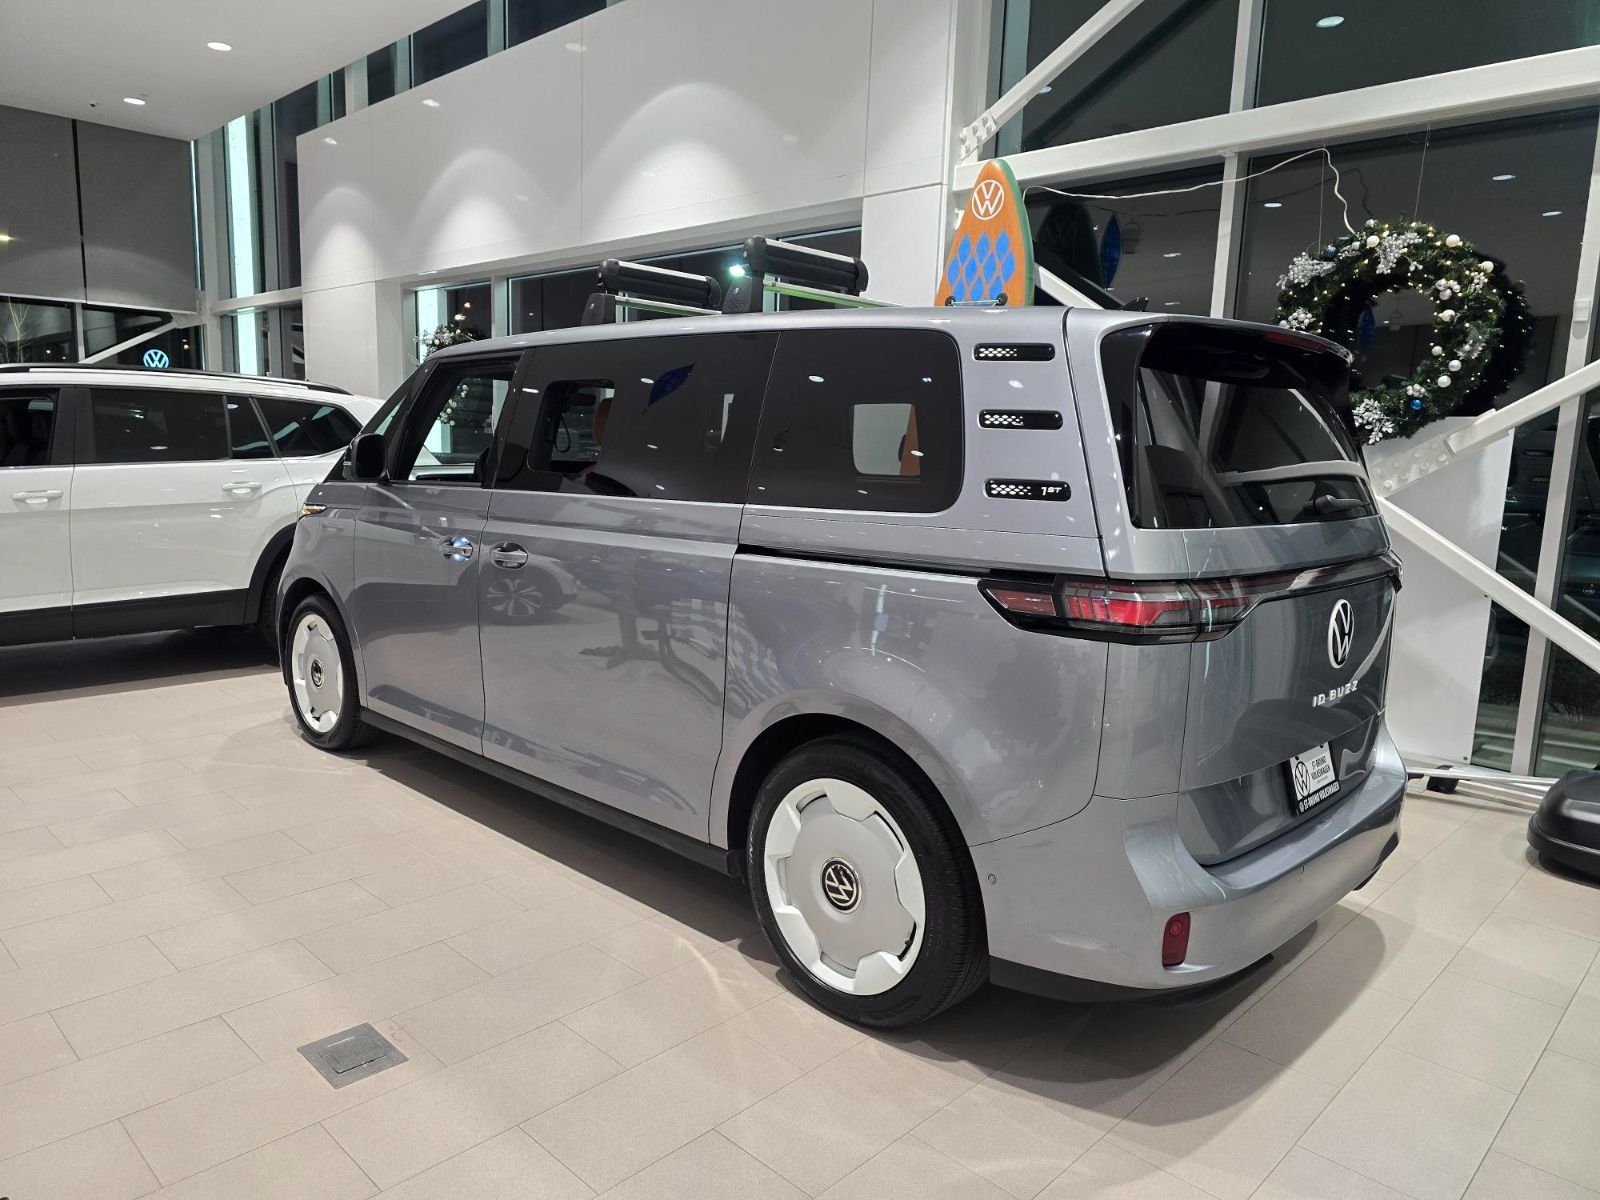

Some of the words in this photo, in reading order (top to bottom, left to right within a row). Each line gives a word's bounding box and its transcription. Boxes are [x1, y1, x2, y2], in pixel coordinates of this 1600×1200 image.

[972, 180, 1004, 219] VW
[143, 349, 169, 368] VW
[1328, 599, 1354, 668] VW
[1329, 680, 1358, 700] BUZZ
[1295, 761, 1310, 797] VW
[824, 863, 857, 907] VW
